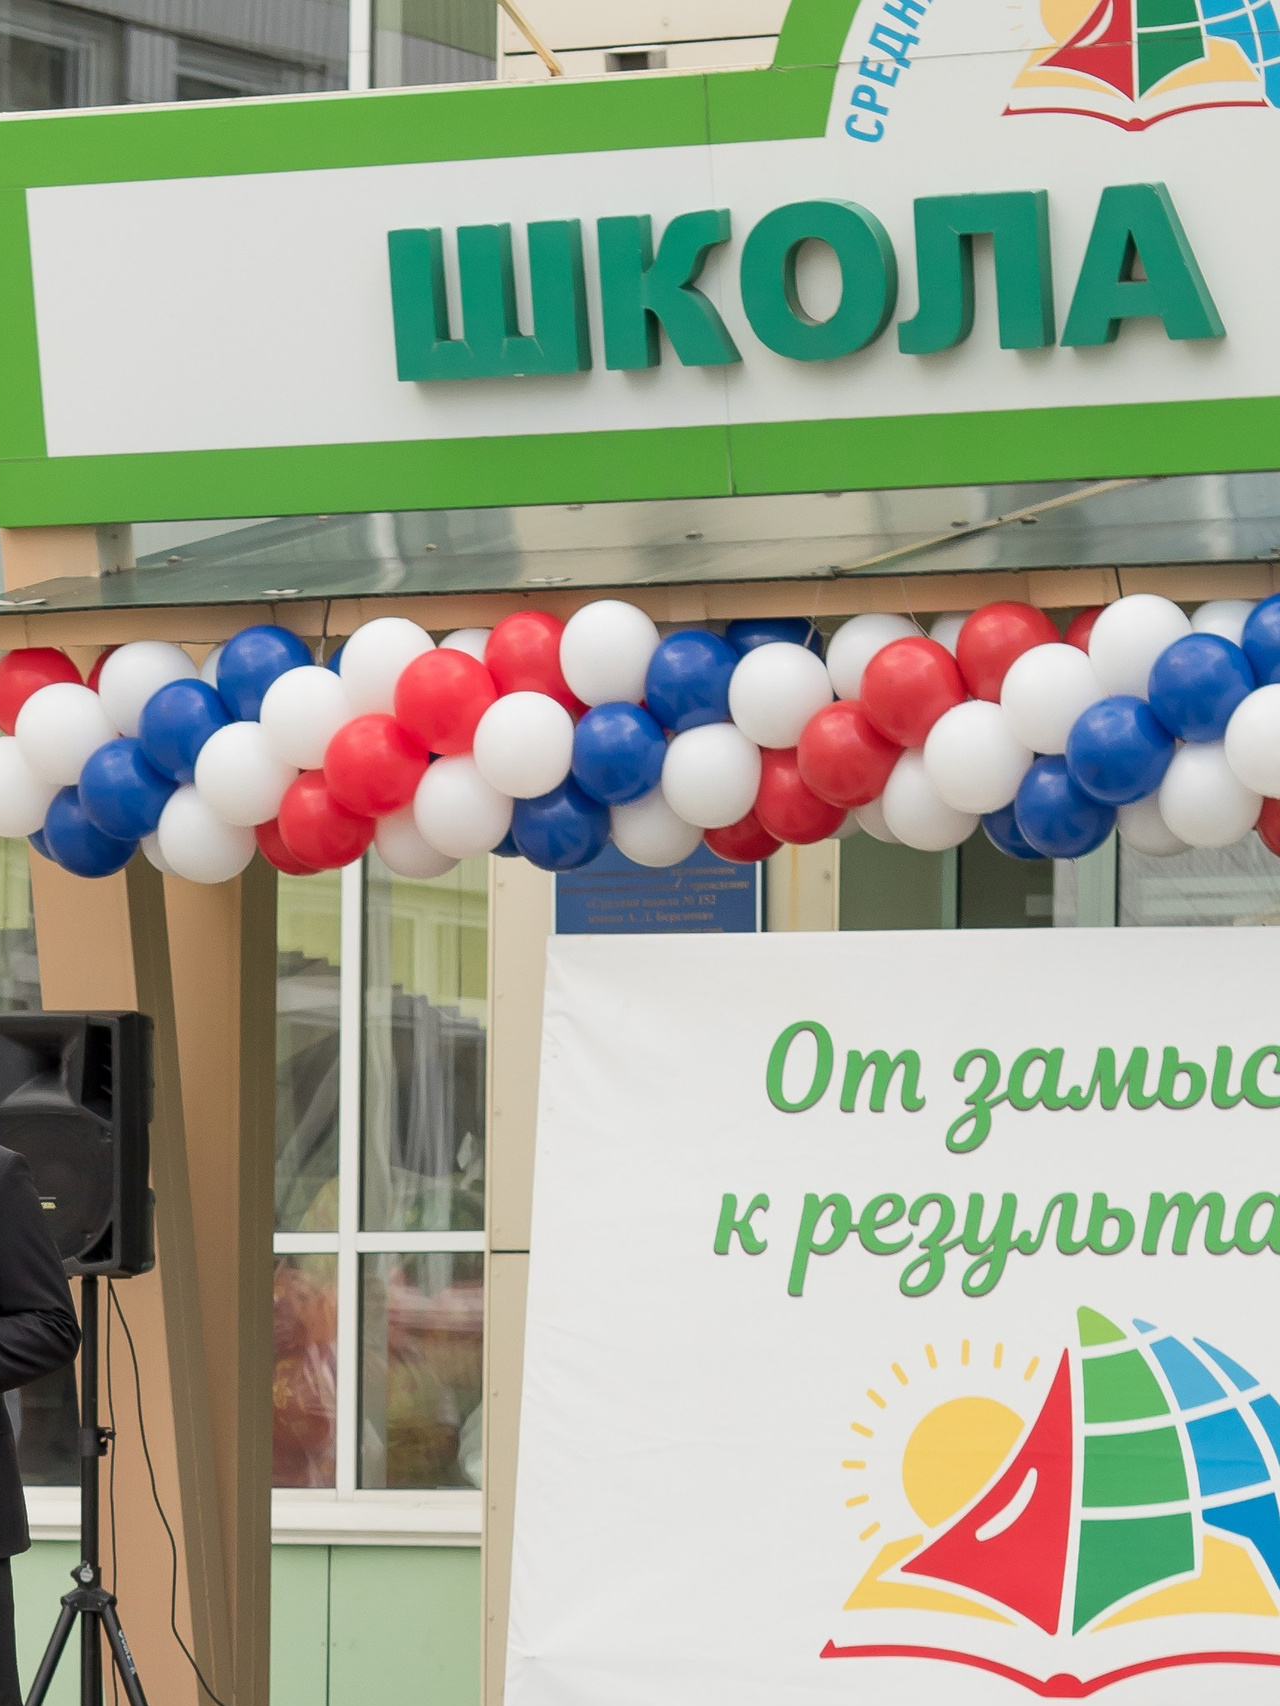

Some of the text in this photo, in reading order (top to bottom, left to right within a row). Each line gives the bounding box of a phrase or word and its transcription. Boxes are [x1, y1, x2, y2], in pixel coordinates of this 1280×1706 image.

[845, 0, 933, 143] СРЕДН
[385, 181, 1227, 383] ШКОЛА
[765, 1020, 1280, 1154] От замыс
[713, 1190, 1280, 1298] к результа
